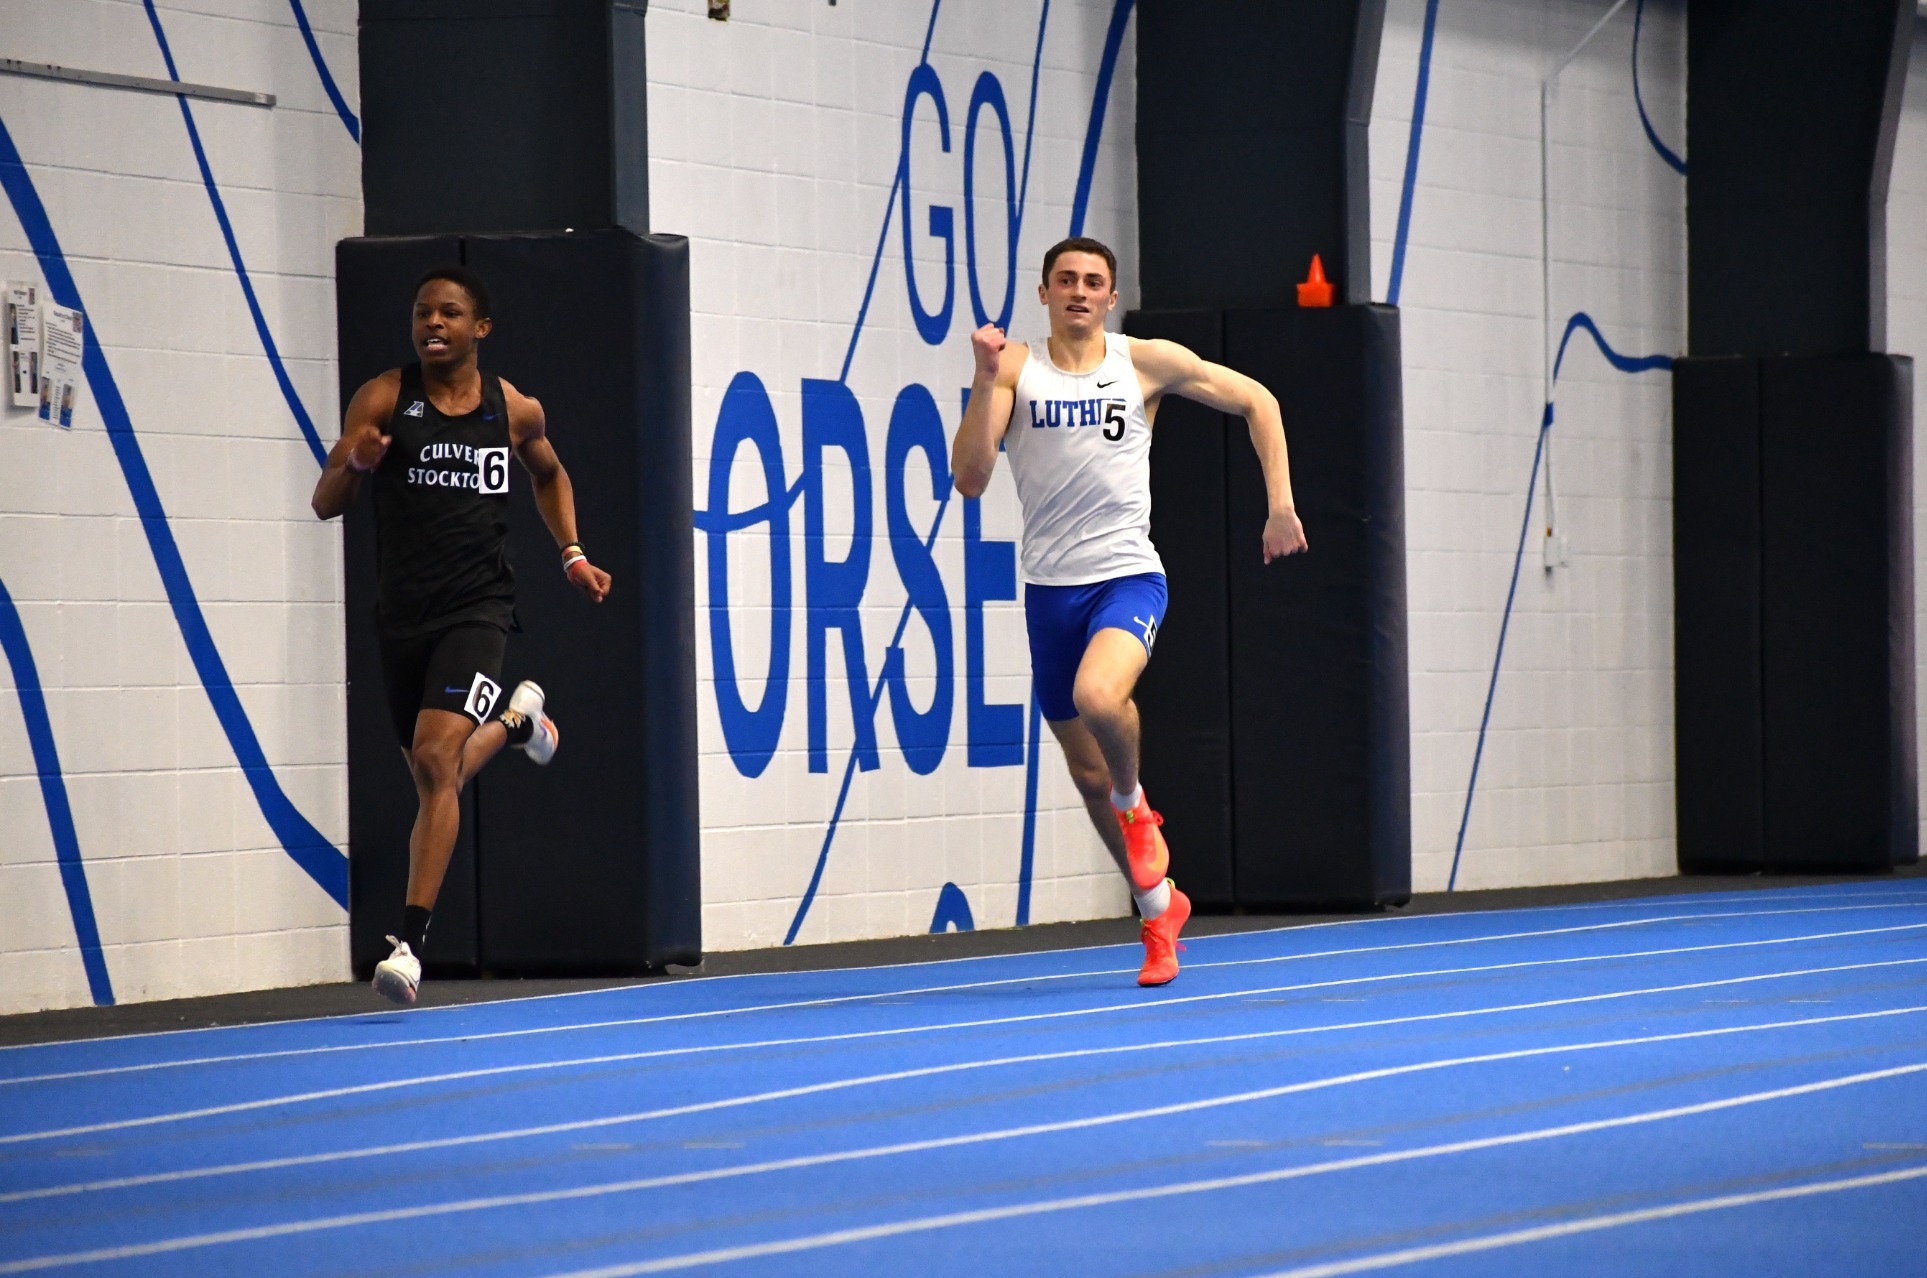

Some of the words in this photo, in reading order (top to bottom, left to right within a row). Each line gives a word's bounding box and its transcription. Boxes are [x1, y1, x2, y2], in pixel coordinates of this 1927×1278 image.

[902, 64, 1017, 346] GO
[1029, 398, 1127, 429] LUTH
[1102, 402, 1126, 442] 5
[483, 451, 505, 491] 6
[472, 680, 495, 718] 6
